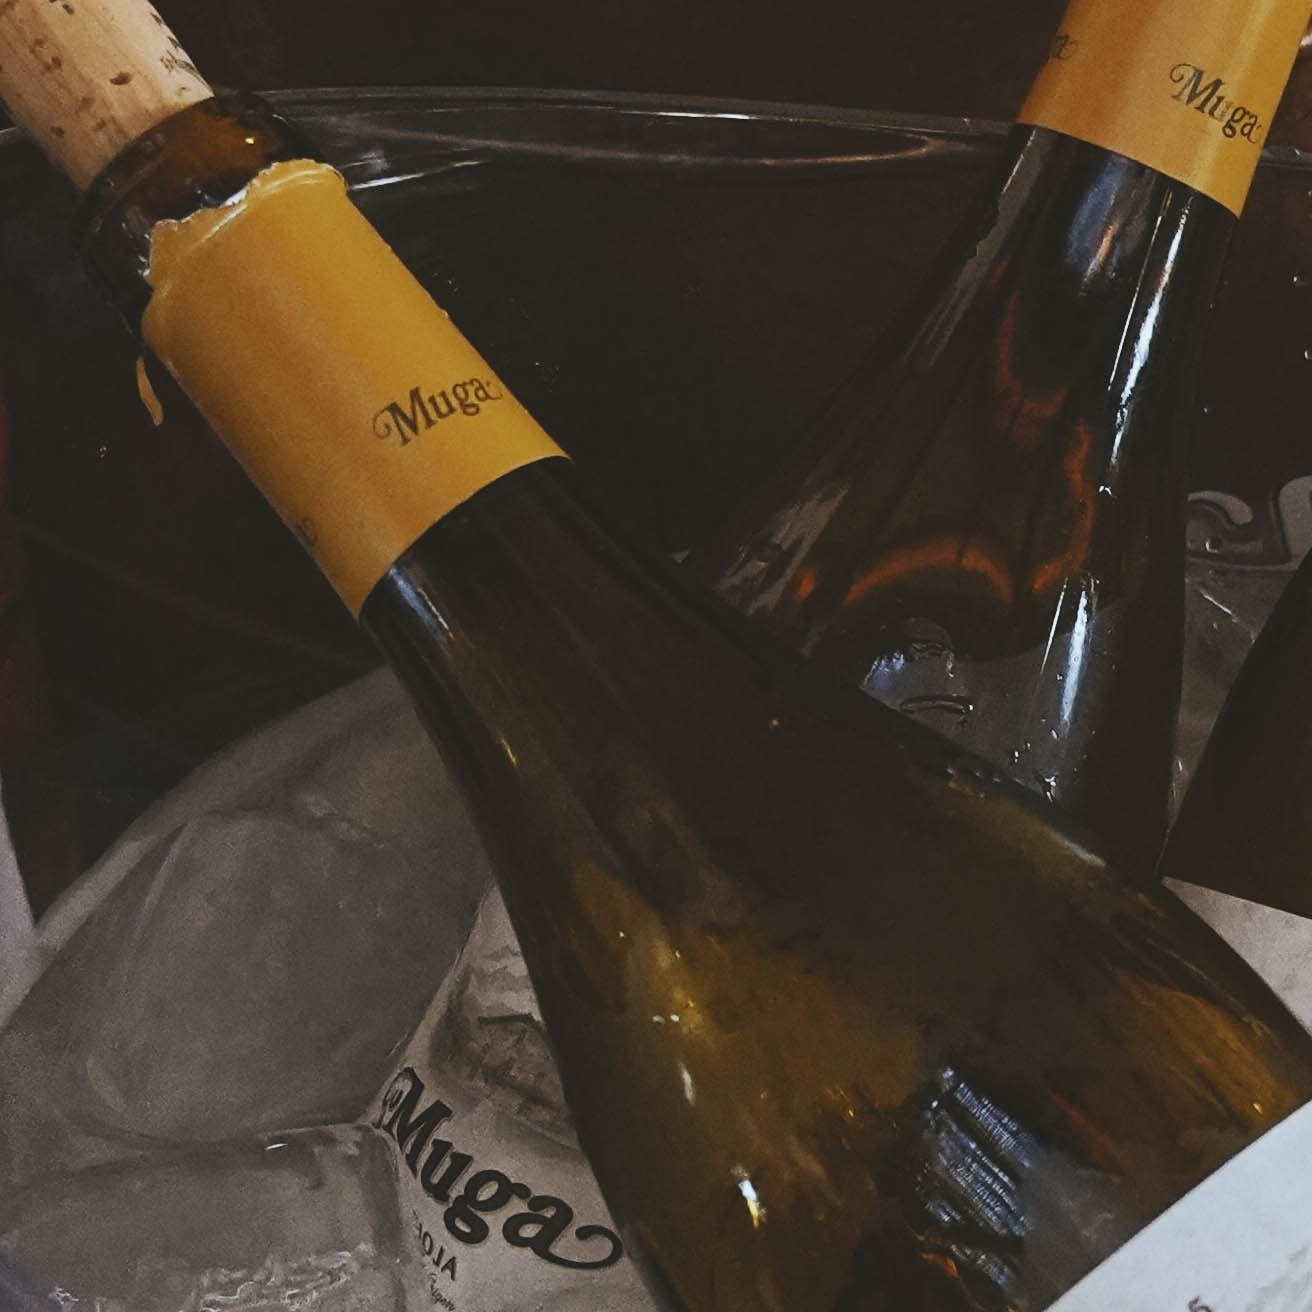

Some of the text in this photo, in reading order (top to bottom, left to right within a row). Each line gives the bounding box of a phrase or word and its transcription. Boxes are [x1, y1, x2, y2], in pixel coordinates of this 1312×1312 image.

[1169, 63, 1262, 144] Muga
[372, 377, 503, 446] Muga
[372, 1067, 623, 1270] Muga
